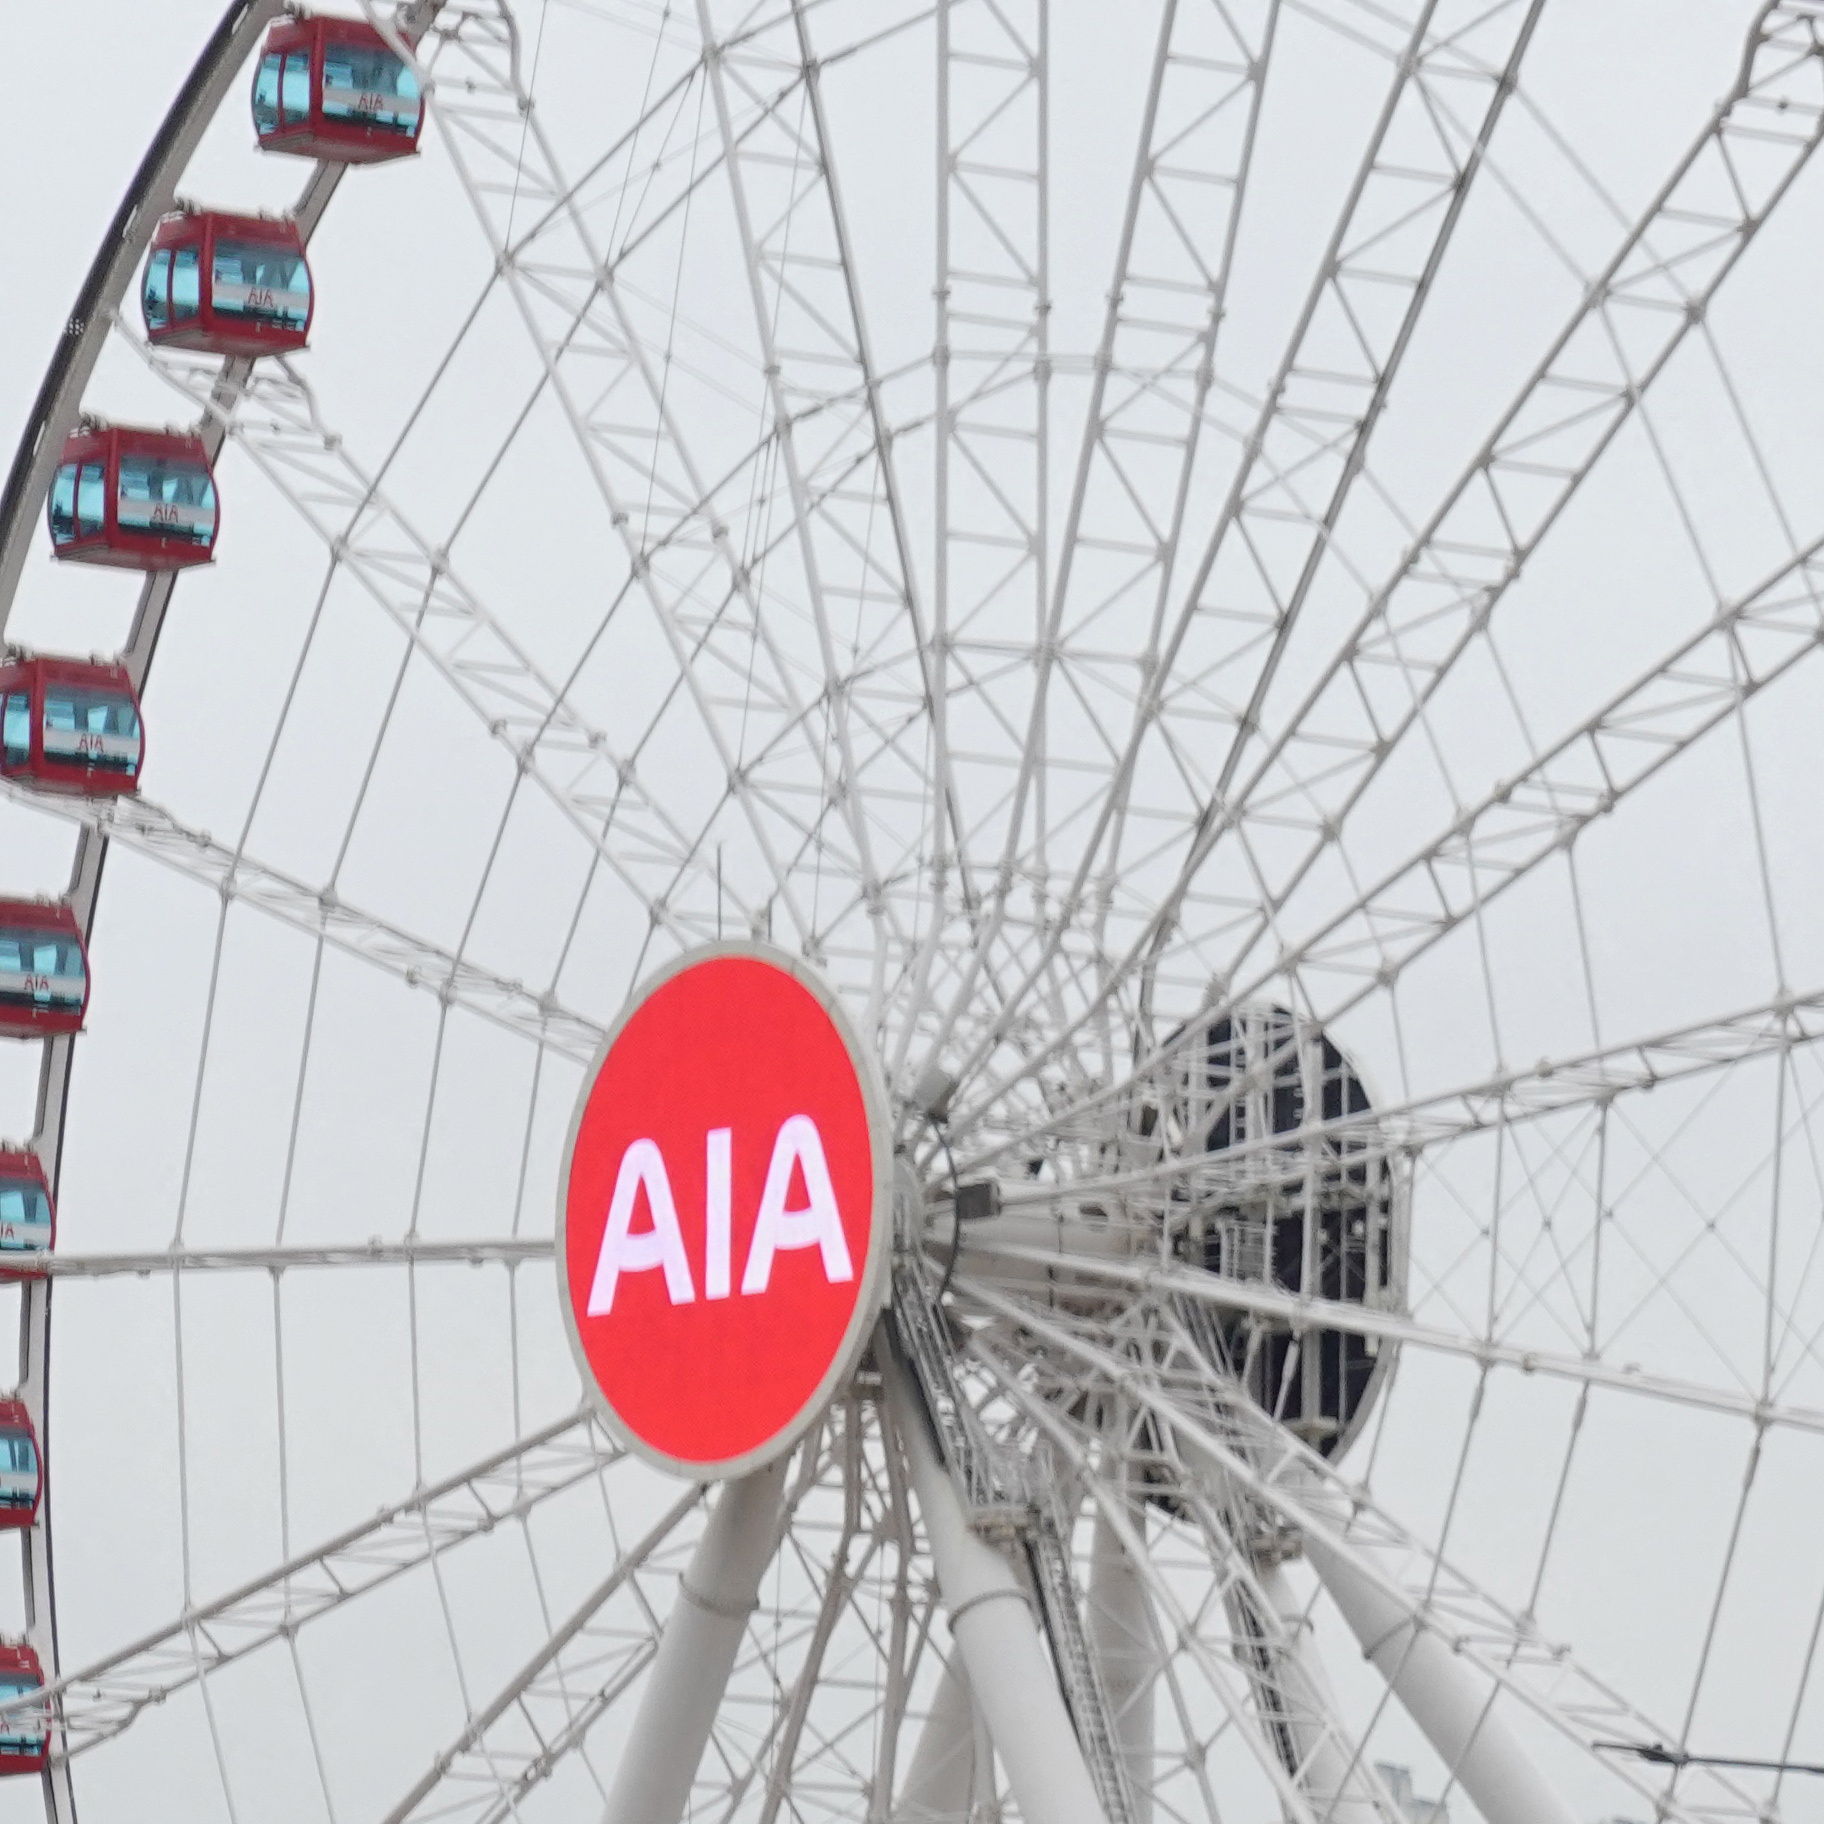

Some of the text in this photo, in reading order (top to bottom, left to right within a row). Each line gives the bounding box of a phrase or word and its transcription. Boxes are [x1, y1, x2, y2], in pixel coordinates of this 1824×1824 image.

[358, 93, 384, 112] AIA
[248, 287, 274, 309] AIA
[152, 503, 179, 523] AIA
[79, 733, 104, 753] AIA
[24, 974, 50, 991] AIA
[587, 1114, 853, 1317] AIA
